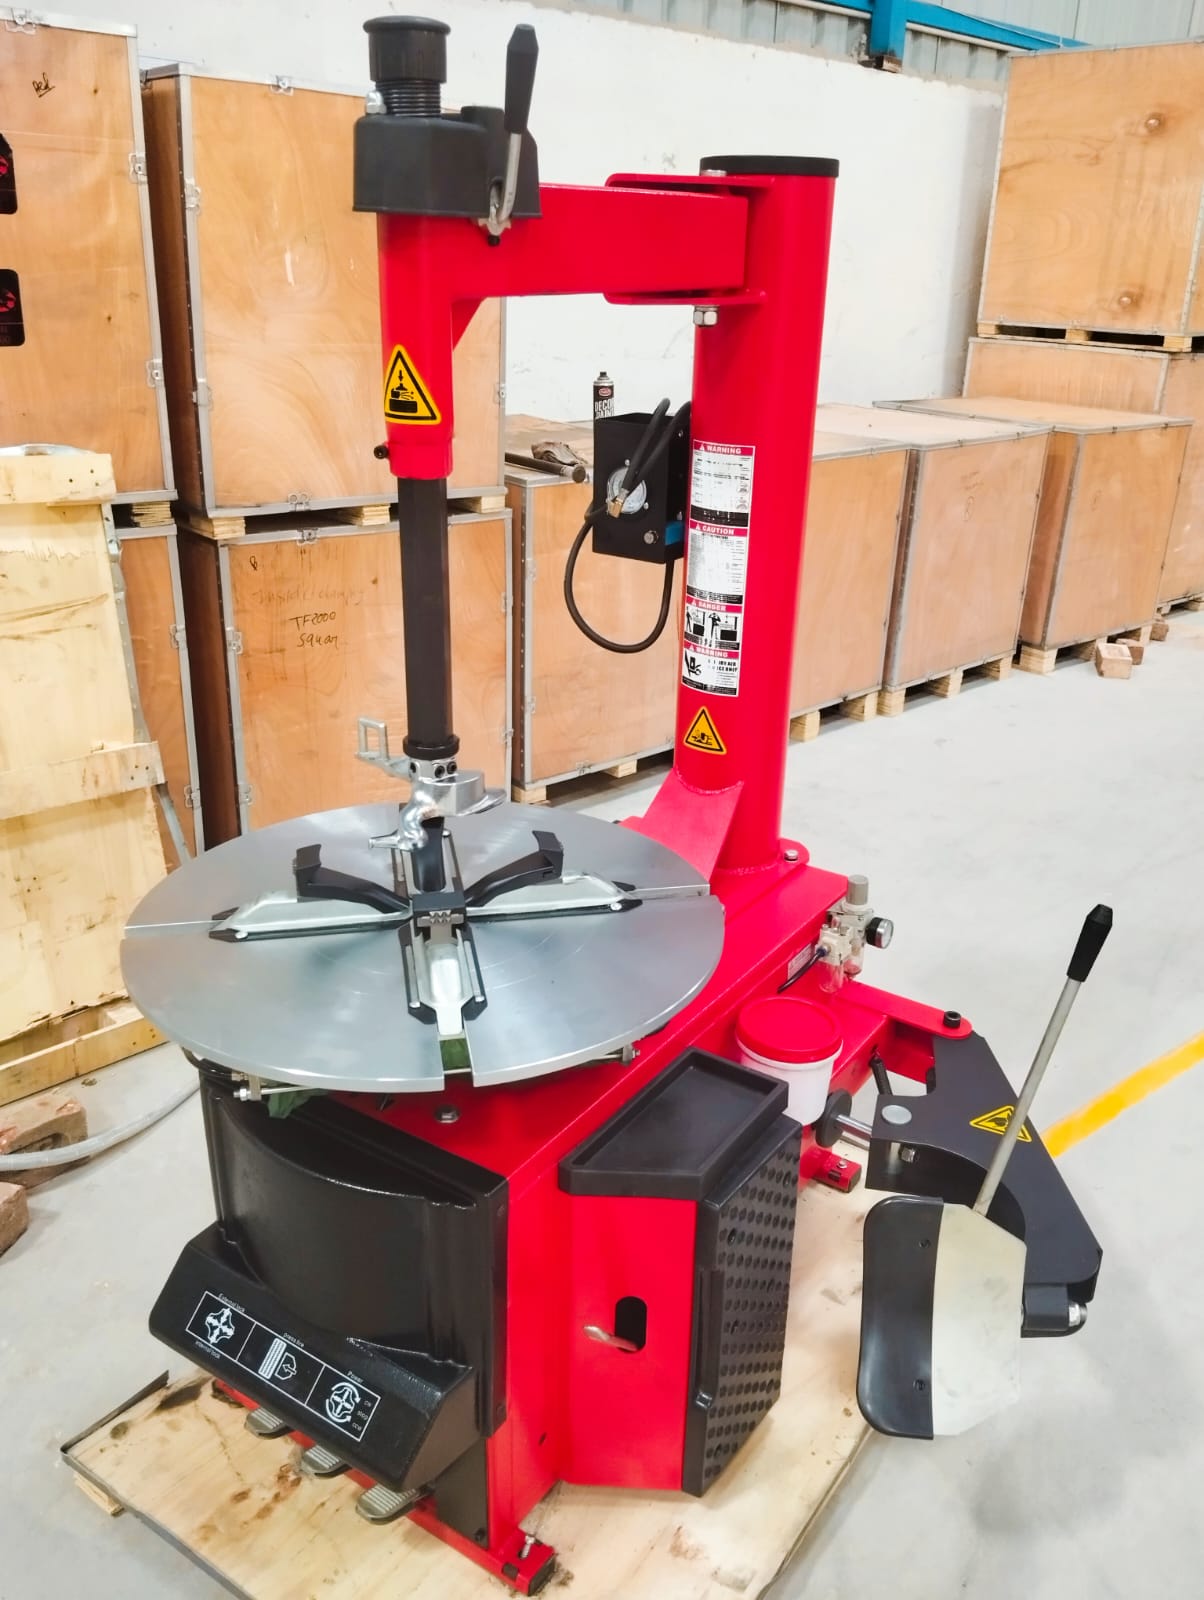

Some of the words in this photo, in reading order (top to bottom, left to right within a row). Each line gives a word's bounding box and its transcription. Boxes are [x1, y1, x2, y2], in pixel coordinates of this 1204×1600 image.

[707, 445, 742, 454] WARNING
[702, 525, 735, 535] CAUTION
[698, 600, 727, 612] DANGER
[696, 647, 729, 658] WARNING
[347, 1370, 363, 1383] Power
